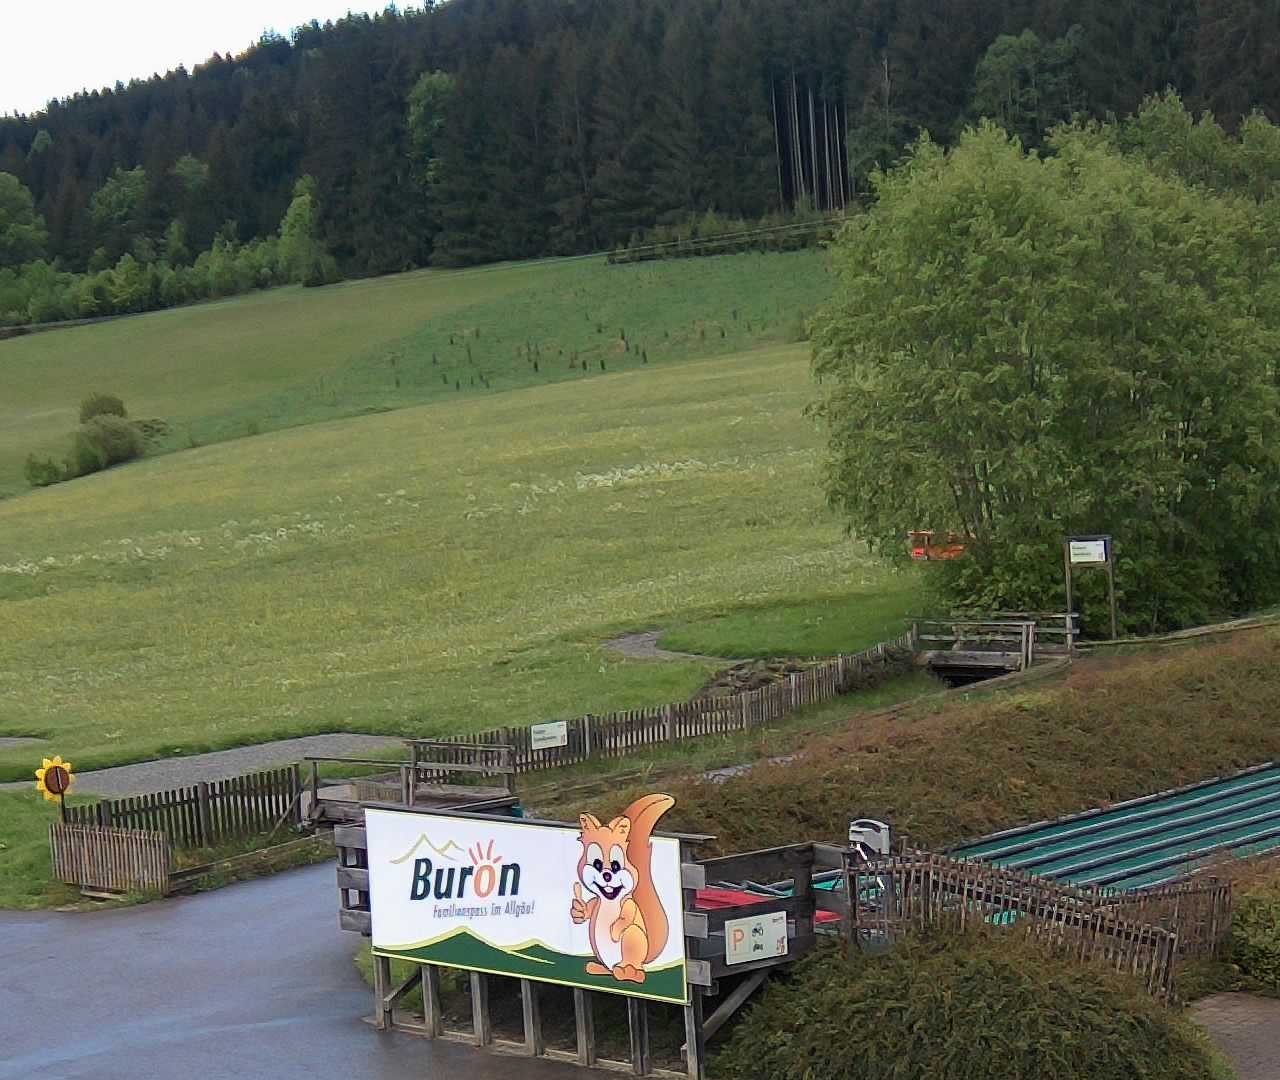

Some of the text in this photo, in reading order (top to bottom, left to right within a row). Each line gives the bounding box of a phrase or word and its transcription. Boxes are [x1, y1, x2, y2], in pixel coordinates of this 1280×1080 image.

[410, 857, 521, 901] Buron
[491, 903, 501, 916] im
[732, 928, 745, 951] P
